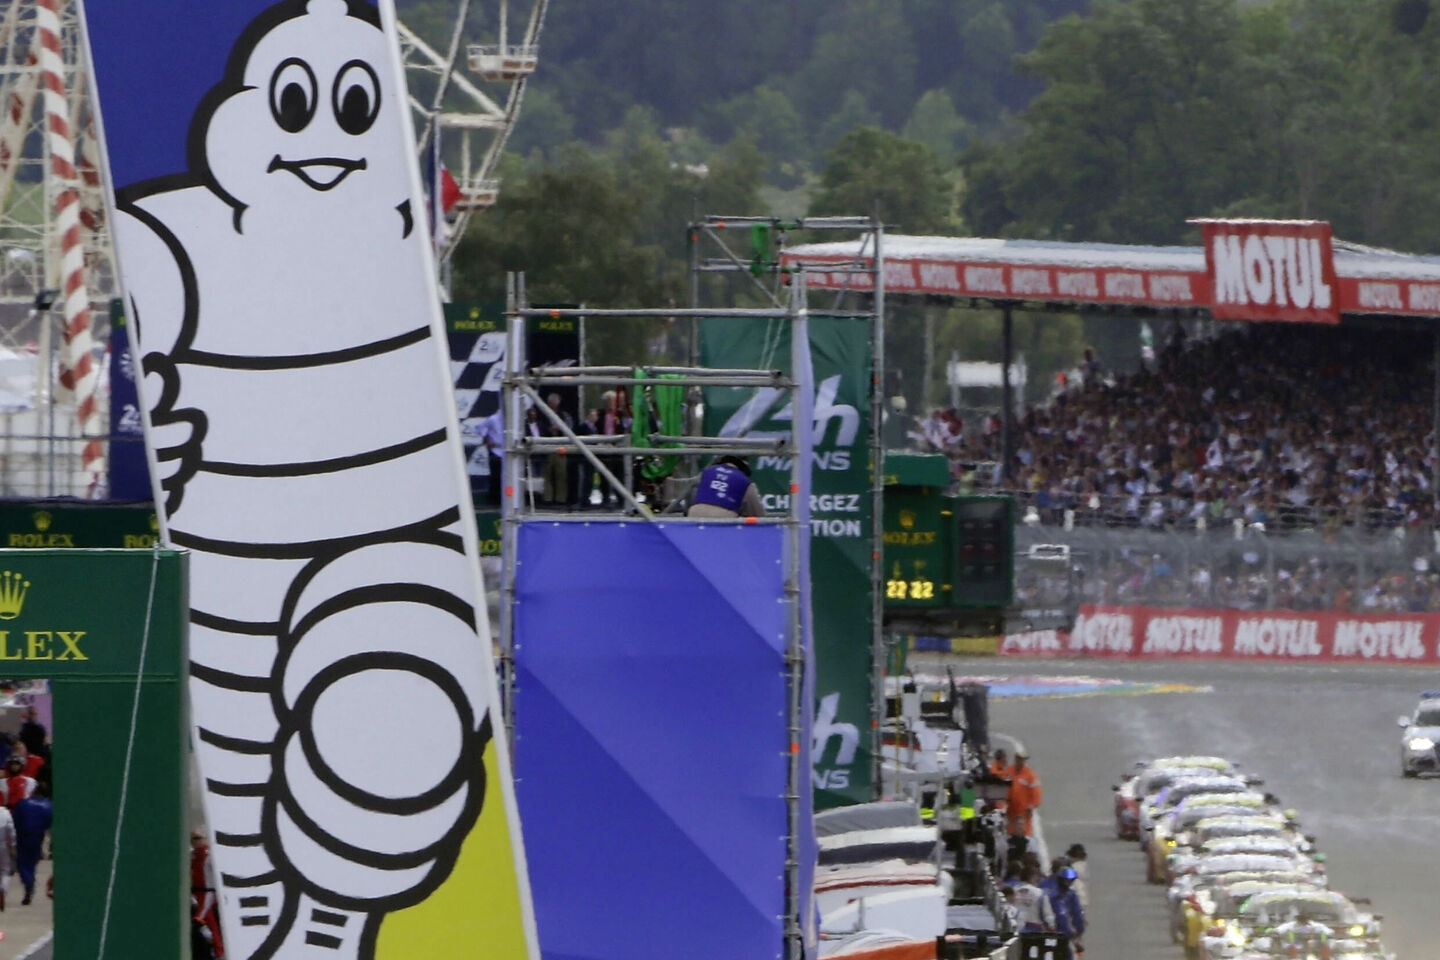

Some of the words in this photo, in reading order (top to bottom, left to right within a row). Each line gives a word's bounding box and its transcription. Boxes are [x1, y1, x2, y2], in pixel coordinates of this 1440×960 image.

[1213, 235, 1332, 309] MOTUL
[9, 533, 74, 548] ROLEX
[1142, 615, 1223, 653] MOTUL
[1233, 617, 1323, 656] MOTUL
[1332, 619, 1426, 659] MOTUL
